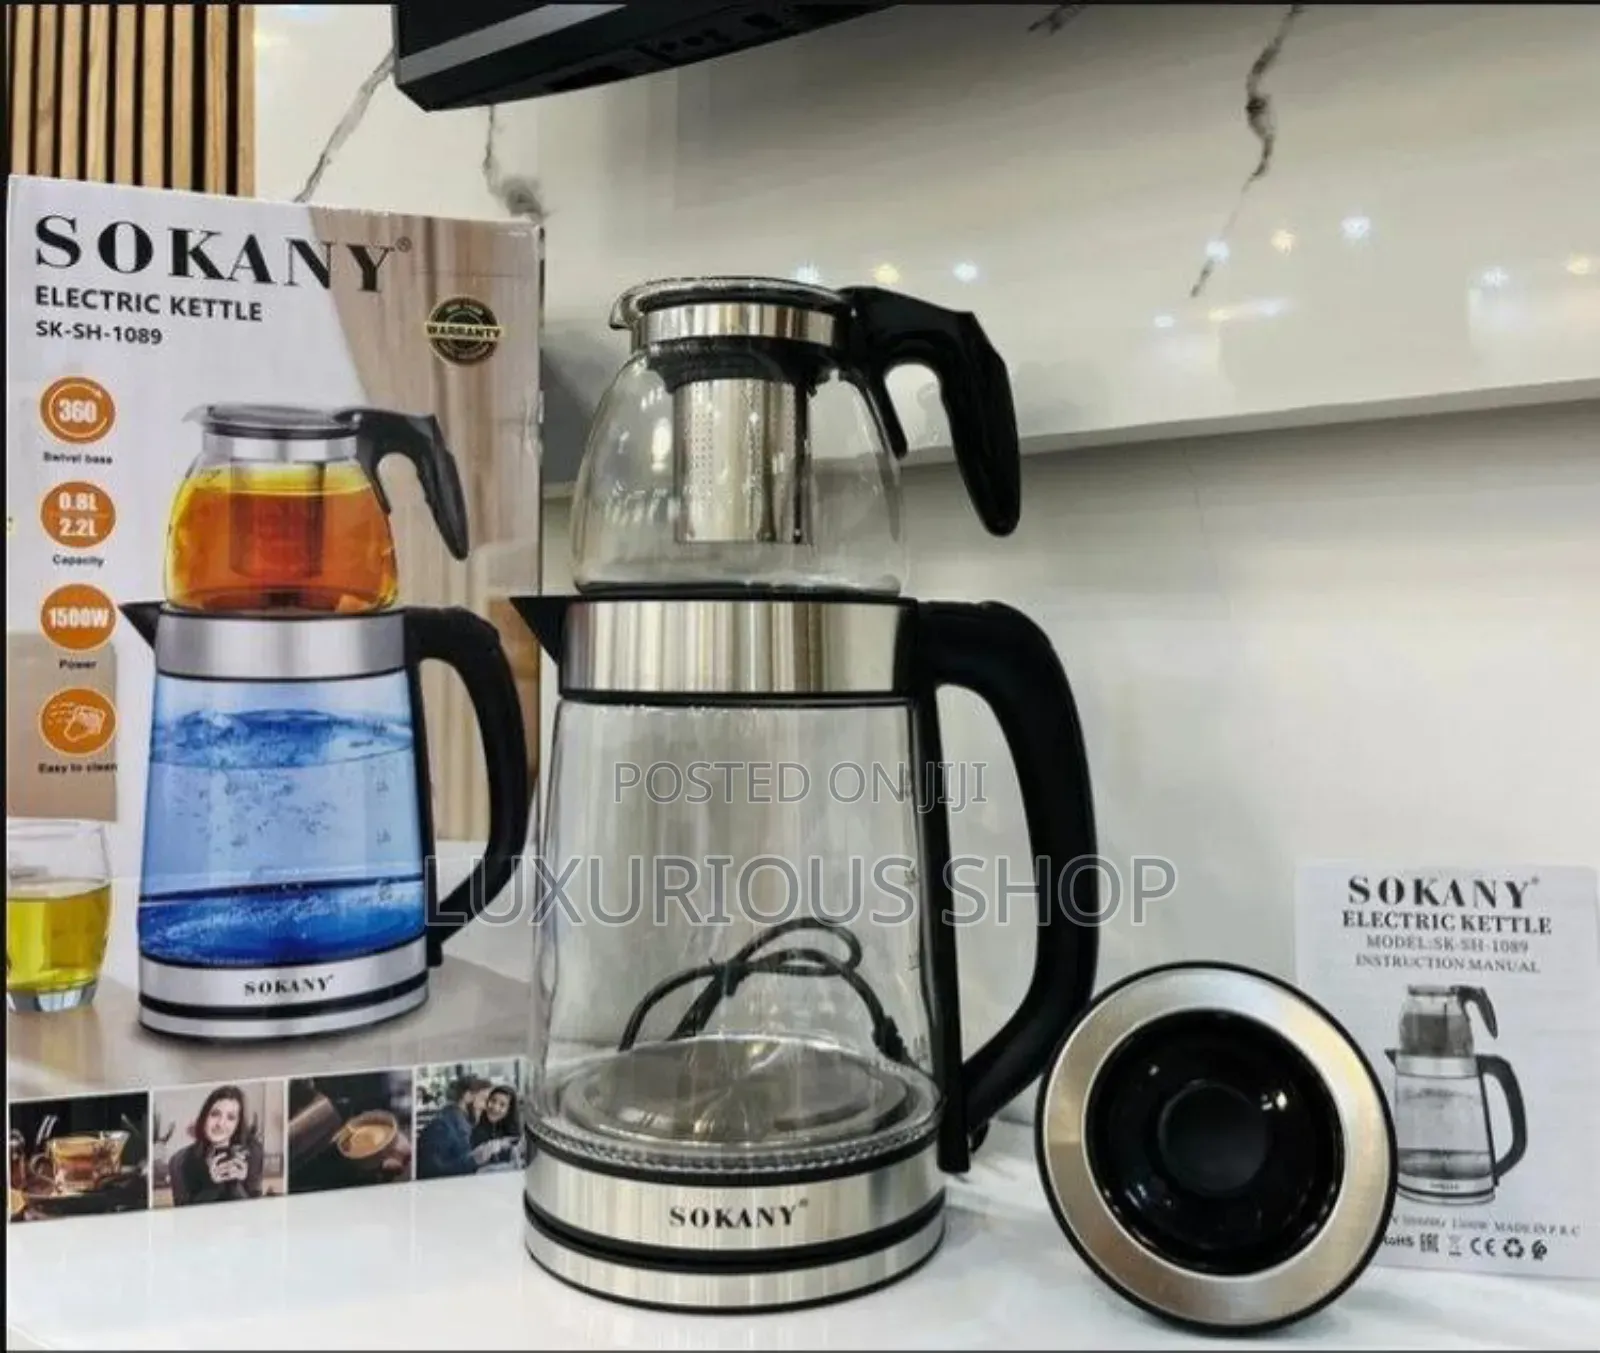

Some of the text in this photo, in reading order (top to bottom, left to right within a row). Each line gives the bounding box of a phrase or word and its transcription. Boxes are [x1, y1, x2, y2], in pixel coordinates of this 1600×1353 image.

[35, 214, 394, 292] SOKANY
[35, 285, 263, 321] ELECTRIC KETTLE
[35, 320, 163, 345] SK-SH-1089
[427, 324, 501, 338] WARRANTY
[59, 399, 97, 423] 360
[85, 454, 113, 465] base
[58, 492, 98, 512] 0.8L
[59, 518, 98, 537] 2.2L
[53, 554, 104, 568] Capacity
[50, 607, 109, 629] 1500W
[59, 659, 97, 670] Power
[38, 763, 118, 774] Easy to clean
[1348, 874, 1529, 910] SOKANY
[1342, 910, 1552, 935] ELECTRIC KETTLE
[1356, 953, 1541, 973] INSTRUCTION MANUAL
[244, 976, 330, 996] SOKANY
[669, 1204, 797, 1229] SOKANY
